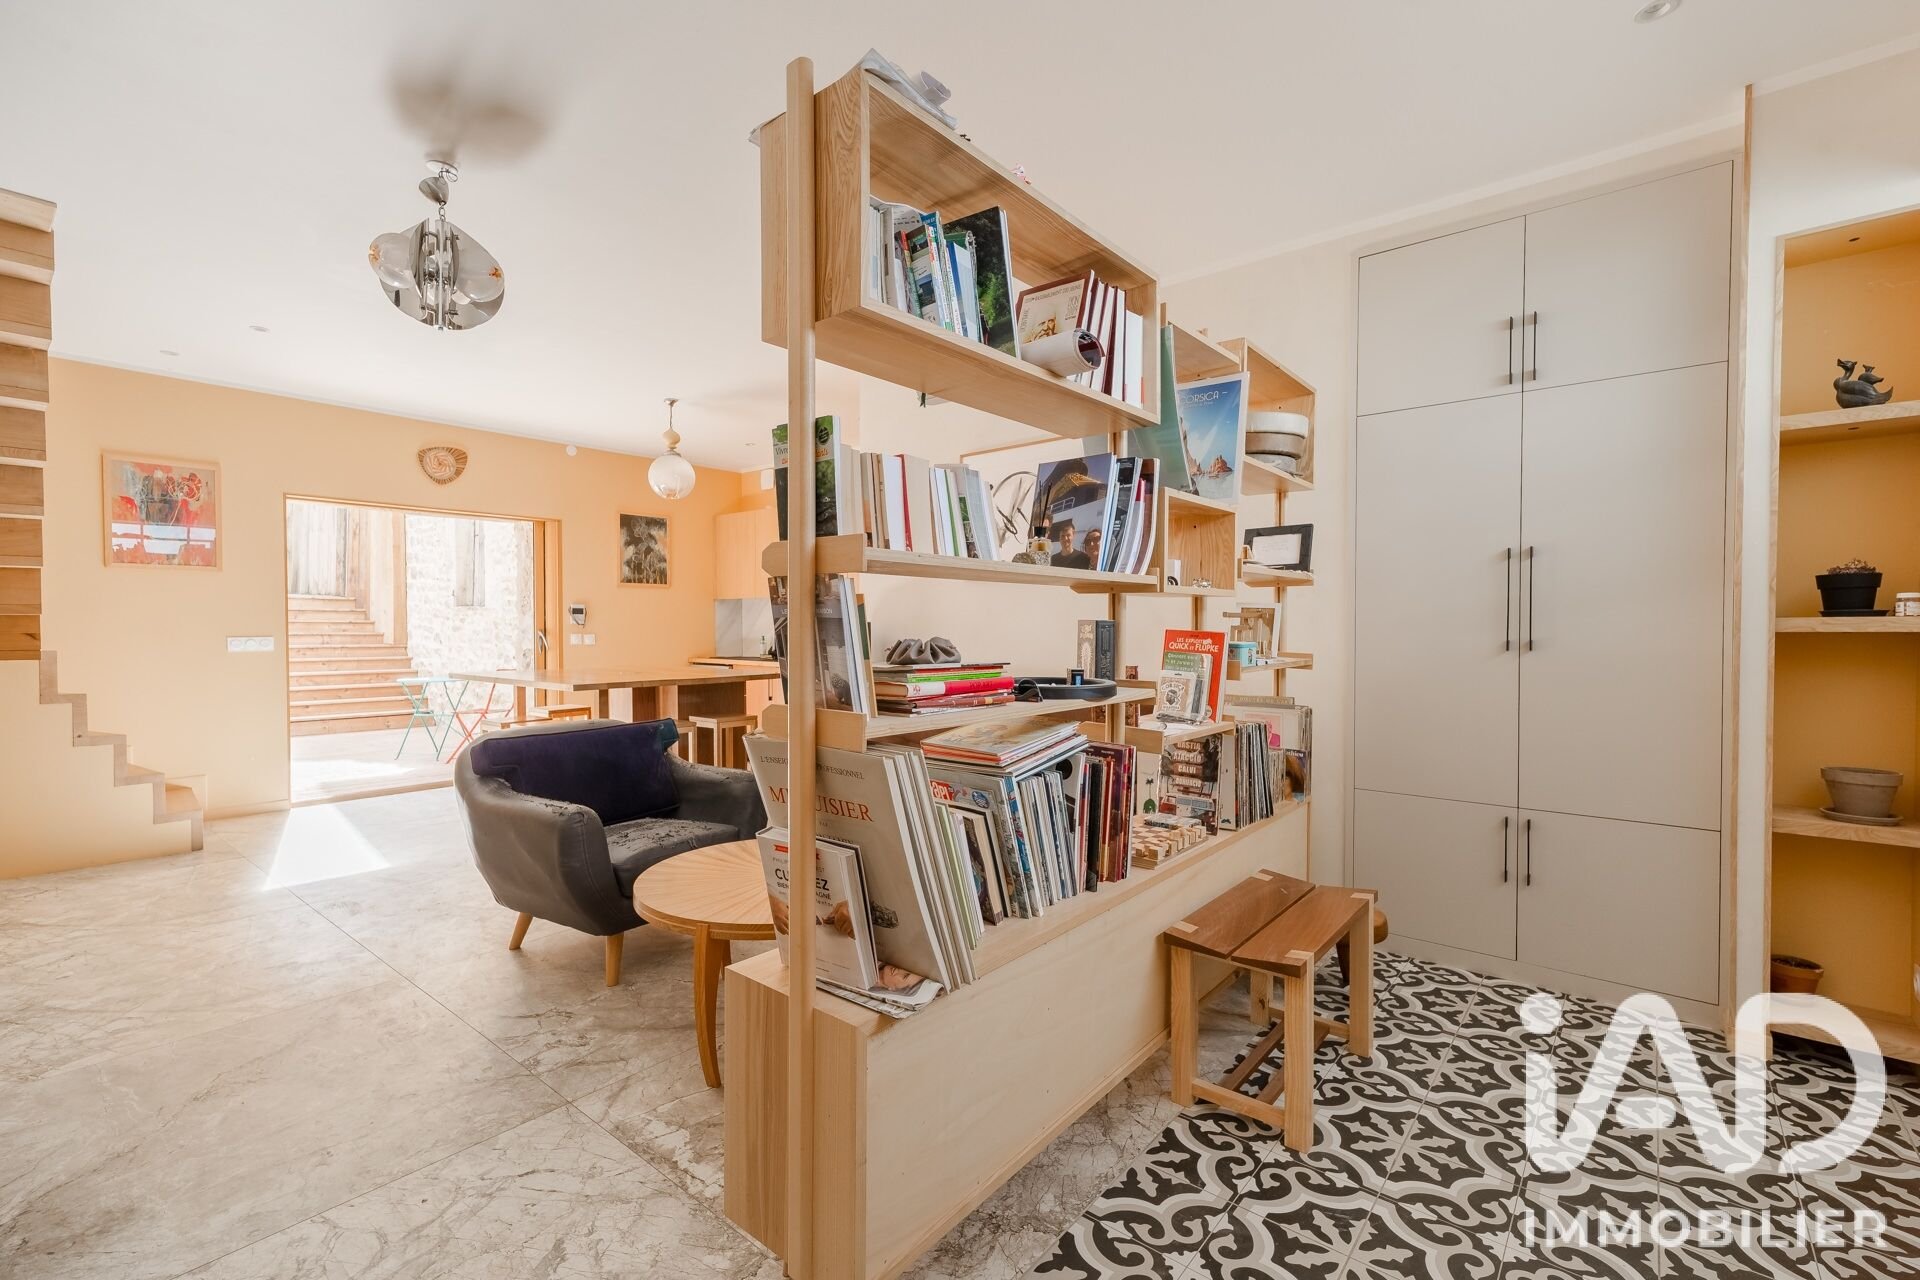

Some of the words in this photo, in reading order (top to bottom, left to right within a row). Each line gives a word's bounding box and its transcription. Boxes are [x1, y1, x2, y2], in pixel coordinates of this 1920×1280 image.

[1168, 641, 1189, 650] QUICK
[1195, 643, 1220, 652] FLUPKE
[1178, 765, 1197, 774] CALVI
